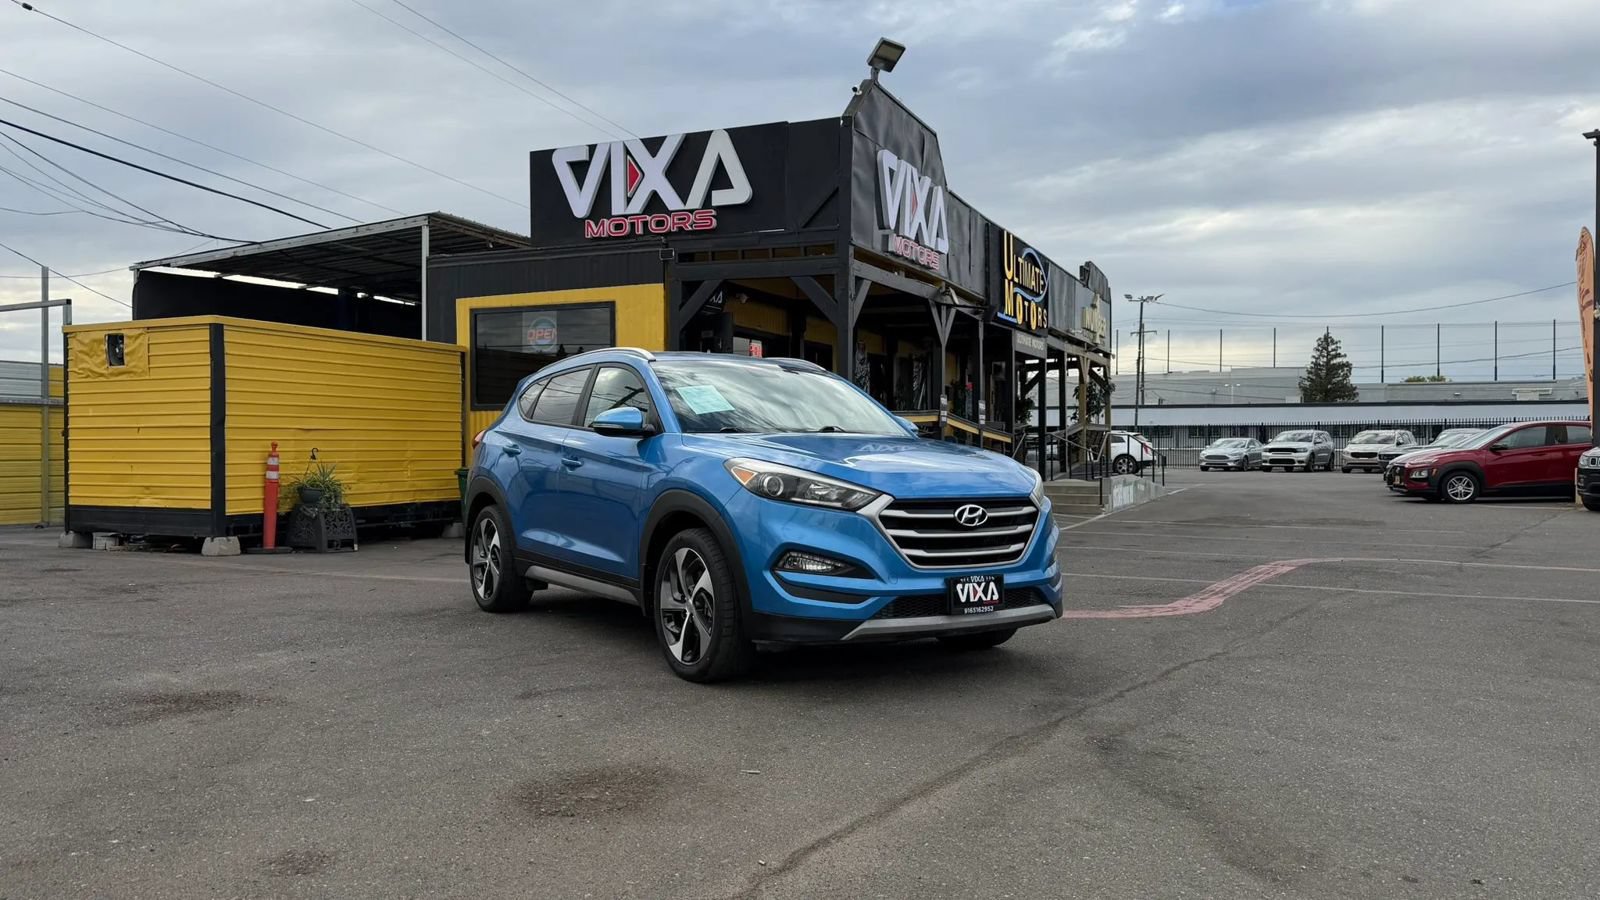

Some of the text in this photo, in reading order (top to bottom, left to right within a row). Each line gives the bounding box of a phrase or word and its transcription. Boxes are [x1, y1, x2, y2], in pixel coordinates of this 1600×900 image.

[552, 128, 752, 218] VIXA
[877, 149, 949, 254] VIXA
[584, 209, 717, 238] MOTORS
[890, 234, 940, 272] MOTORS
[956, 581, 999, 603] VIXA
